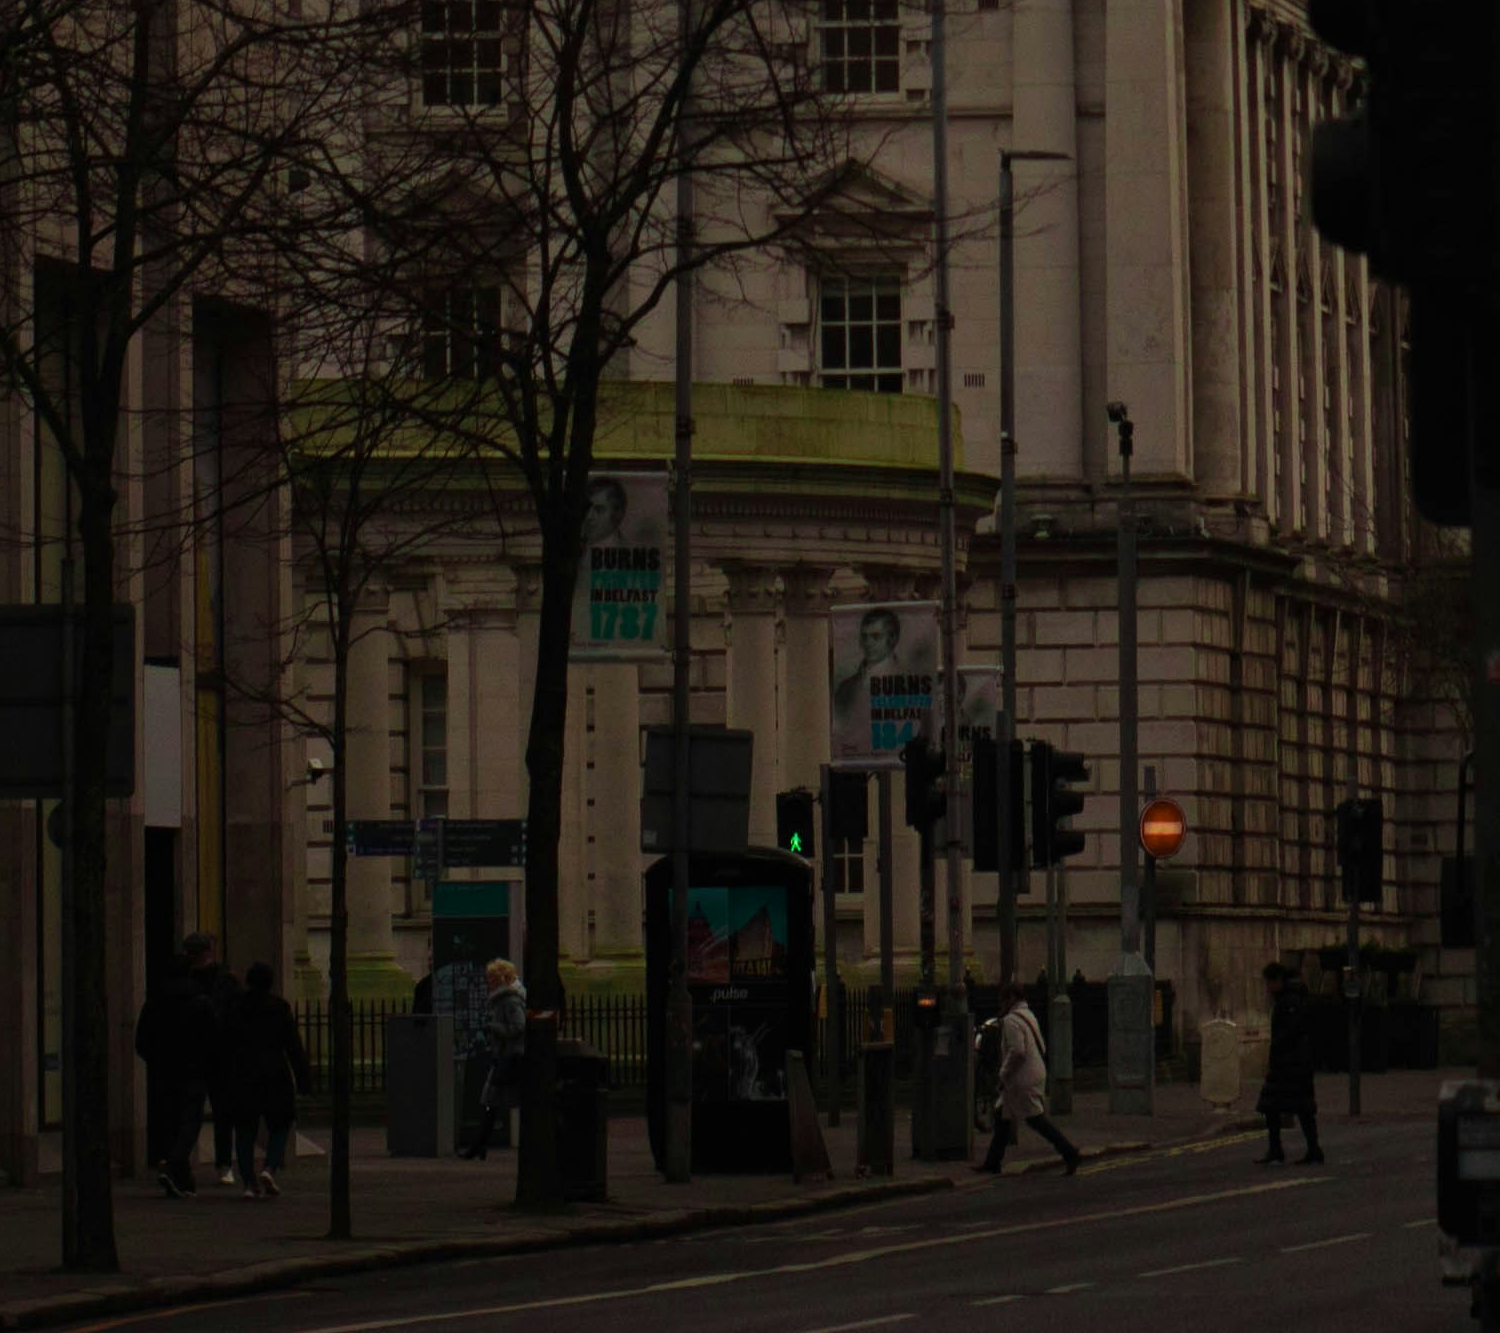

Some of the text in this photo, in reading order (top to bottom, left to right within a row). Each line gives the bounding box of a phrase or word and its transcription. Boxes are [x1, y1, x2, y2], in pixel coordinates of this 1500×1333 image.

[591, 548, 660, 569] BURNS
[591, 603, 657, 640] 1787
[870, 675, 933, 695] BURNS
